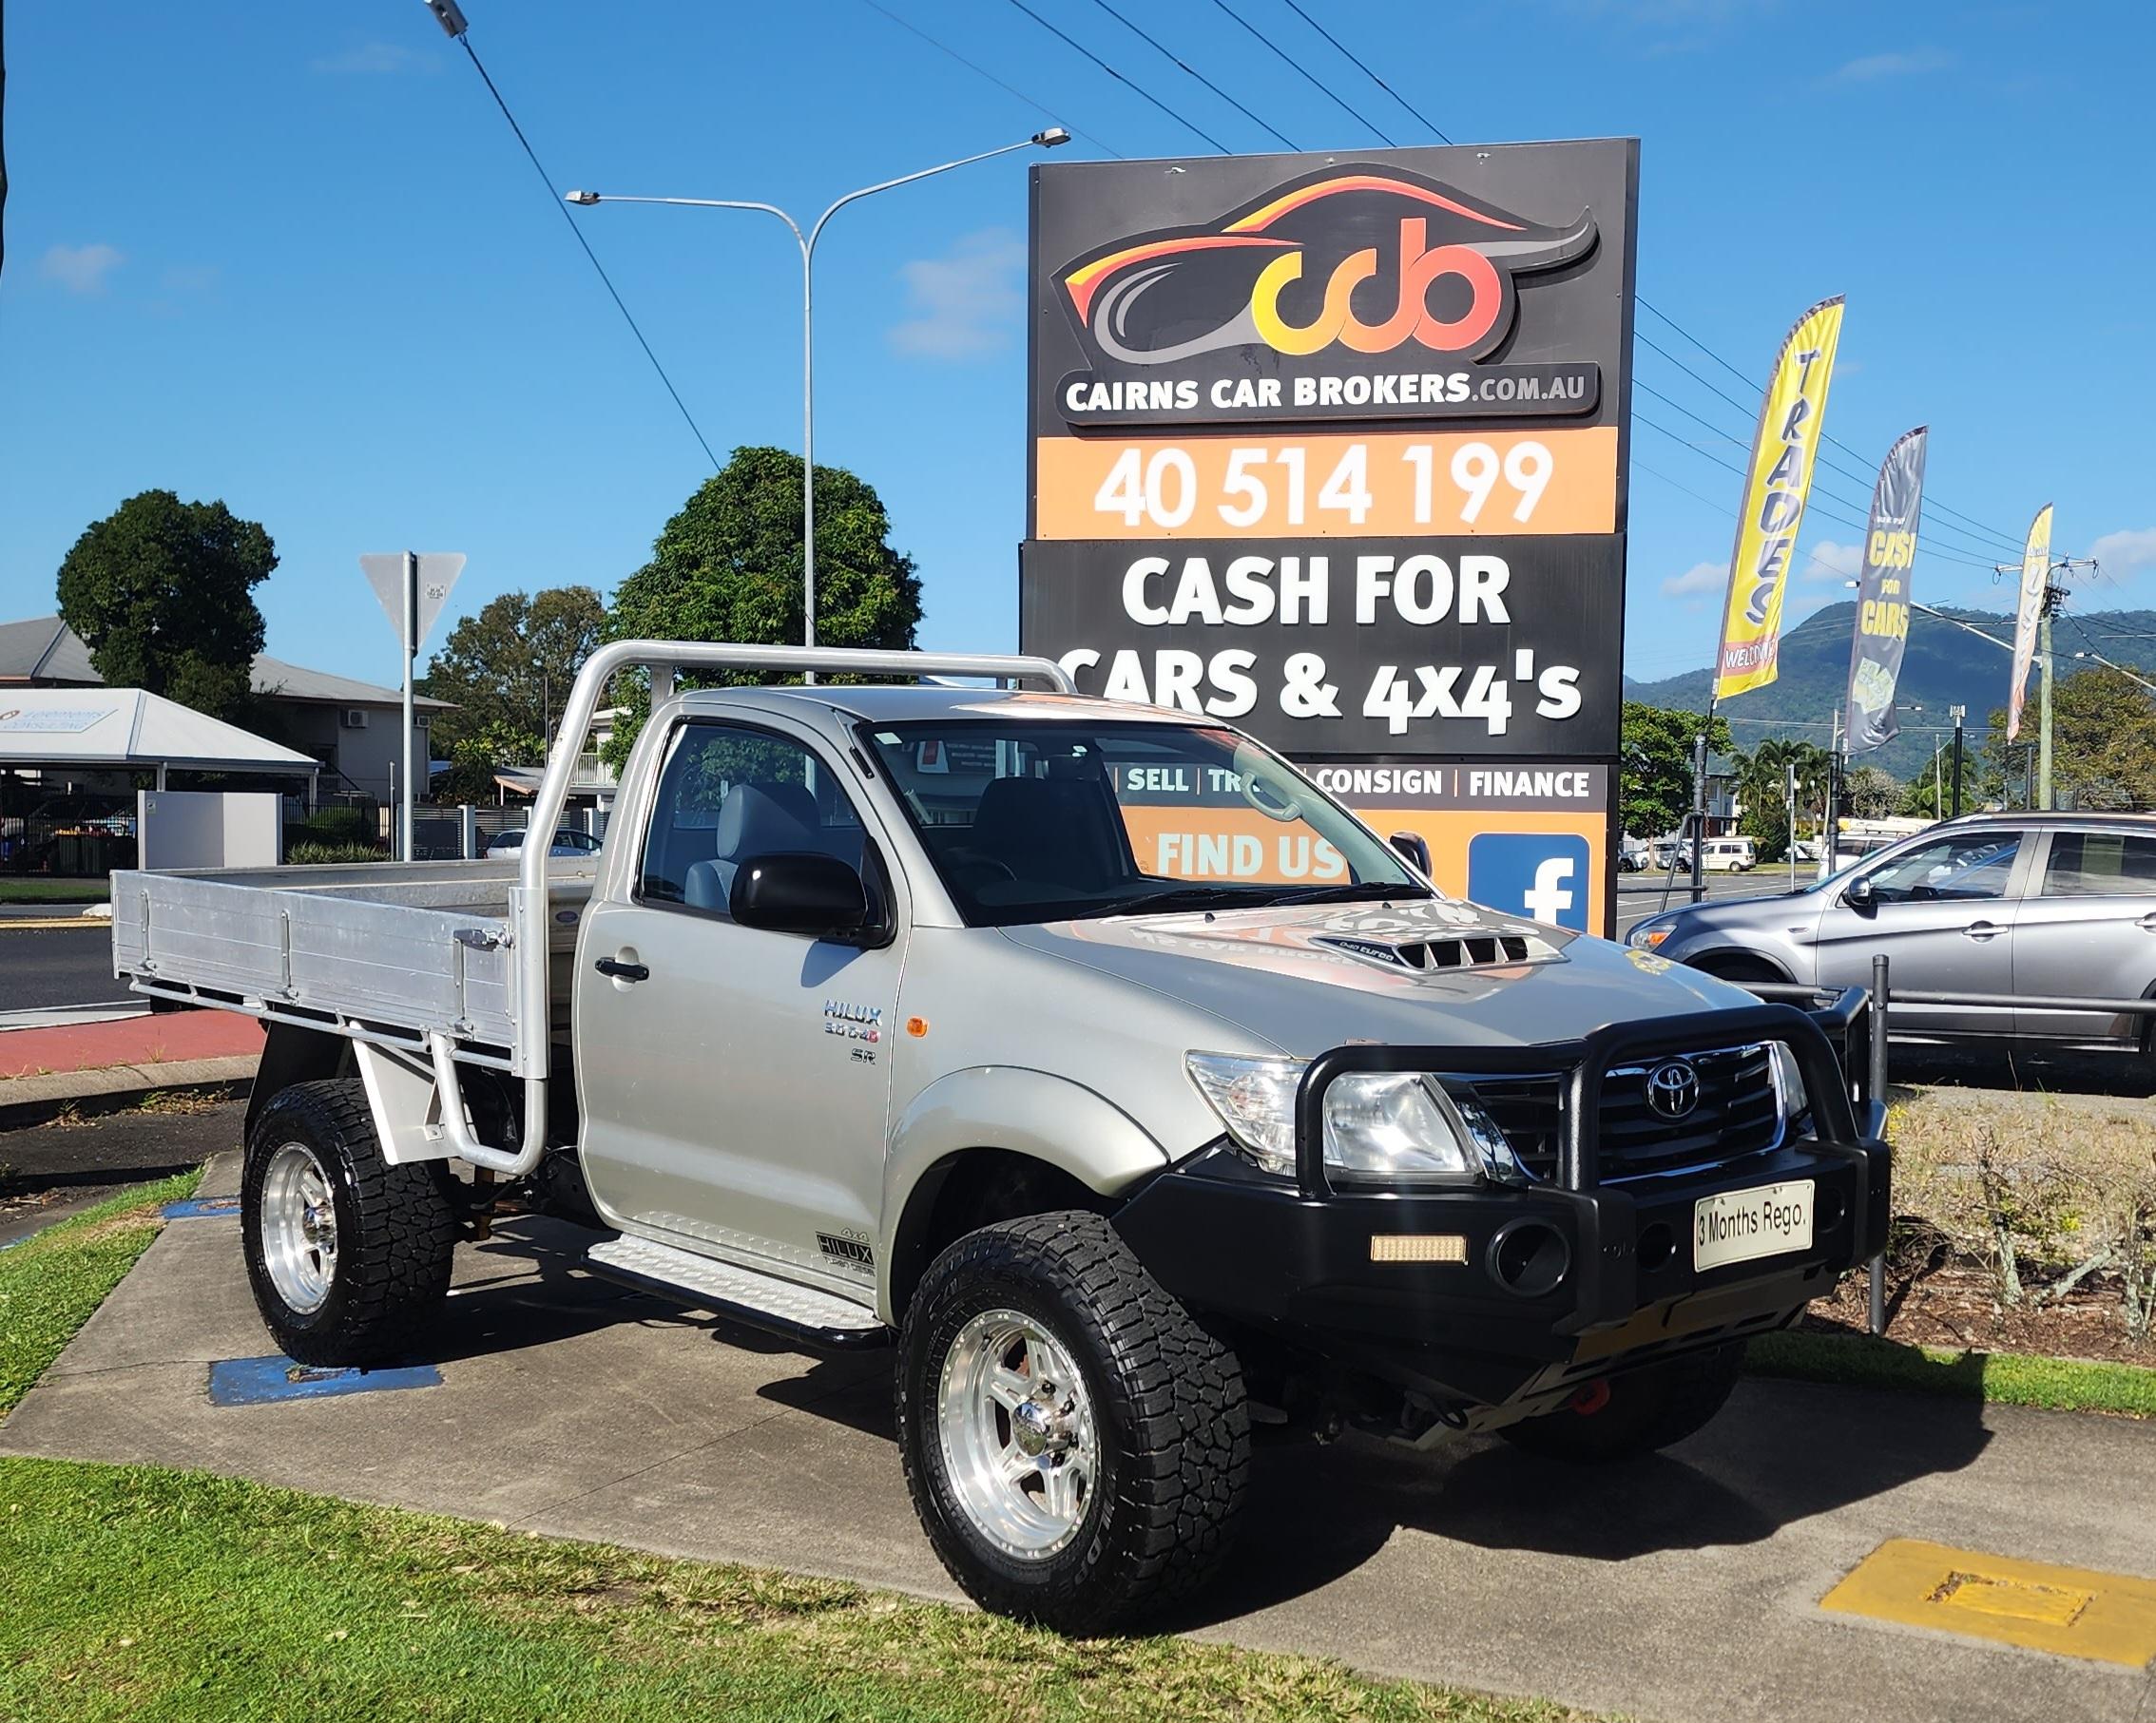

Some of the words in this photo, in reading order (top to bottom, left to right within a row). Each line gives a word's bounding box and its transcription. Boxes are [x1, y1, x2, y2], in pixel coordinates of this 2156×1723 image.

[1066, 379, 1199, 412] CAIRNS
[1210, 378, 1282, 409] CAR
[1094, 447, 1197, 528] 40
[1217, 444, 1373, 527] 514
[1401, 440, 1553, 525] 199
[1123, 556, 1329, 626] CASH
[1357, 554, 1511, 625] FOR
[1860, 599, 1910, 642] CARS
[1280, 652, 1343, 718] &
[1127, 768, 1189, 793] SELL
[1316, 768, 1442, 794] CONSIGN
[1469, 771, 1589, 797] FINANCE
[1157, 833, 1263, 877] FIND
[1279, 834, 1345, 879] US
[824, 999, 882, 1026] HILUX
[850, 1047, 877, 1065] SR
[1698, 1215, 1705, 1247] 3
[1708, 1206, 1758, 1244] Months
[1763, 1200, 1806, 1235] Rego.
[818, 1235, 873, 1265] HILUX
